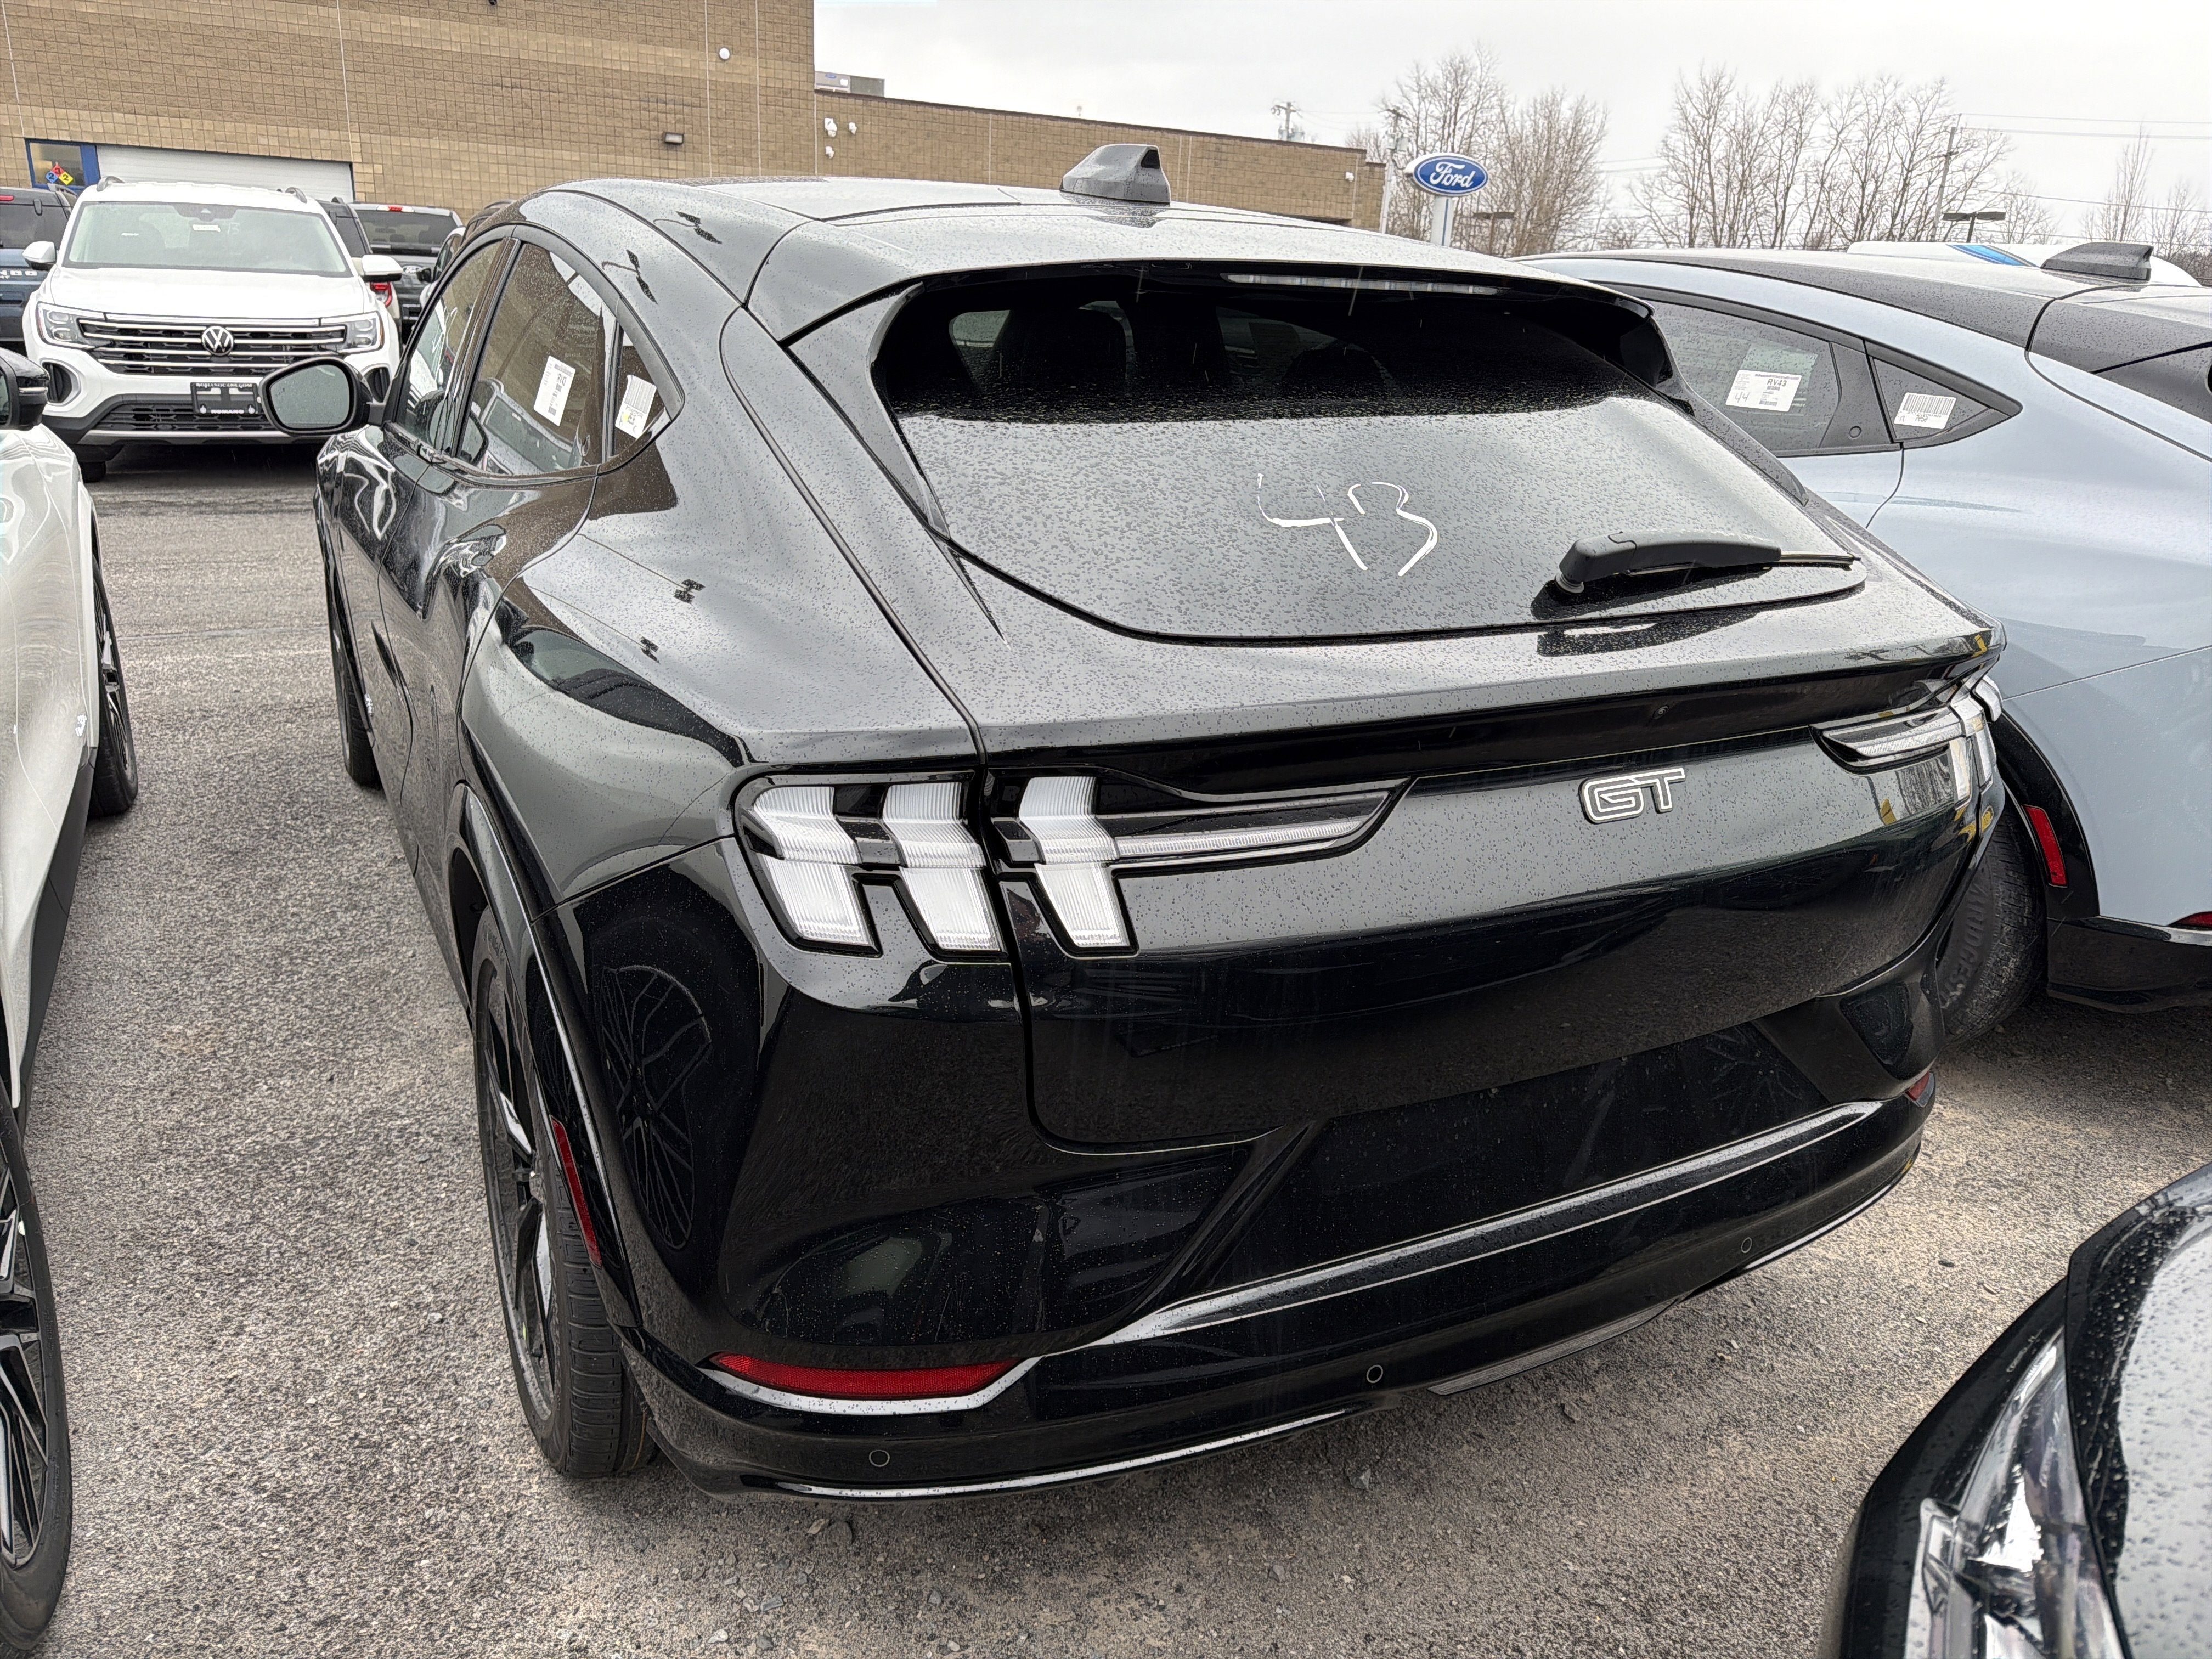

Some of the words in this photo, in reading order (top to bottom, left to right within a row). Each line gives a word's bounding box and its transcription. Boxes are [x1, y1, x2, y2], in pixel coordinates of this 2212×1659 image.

[1429, 161, 1476, 188] Ford
[1767, 379, 1787, 387] RV43
[1735, 392, 1751, 403] 44
[1256, 473, 1438, 577] 43
[1579, 768, 1686, 823] GT
